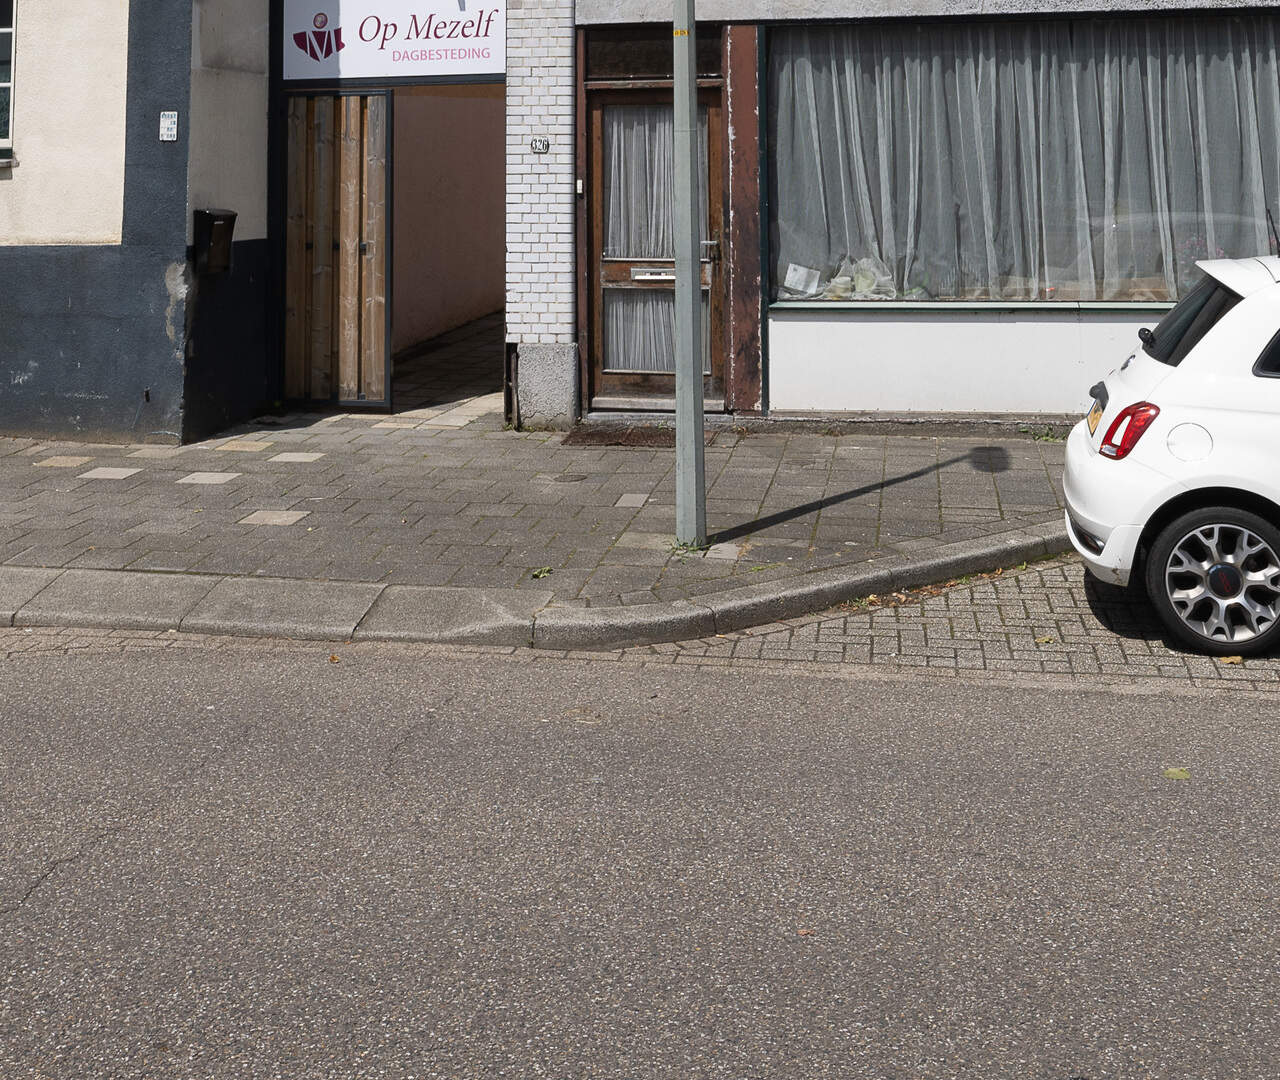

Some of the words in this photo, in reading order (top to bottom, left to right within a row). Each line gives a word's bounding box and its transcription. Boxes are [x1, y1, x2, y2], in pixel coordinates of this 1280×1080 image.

[358, 15, 398, 50] Op
[404, 9, 499, 41] Mezelf
[392, 47, 491, 62] DAGBESTEDING
[532, 138, 547, 151] 326
